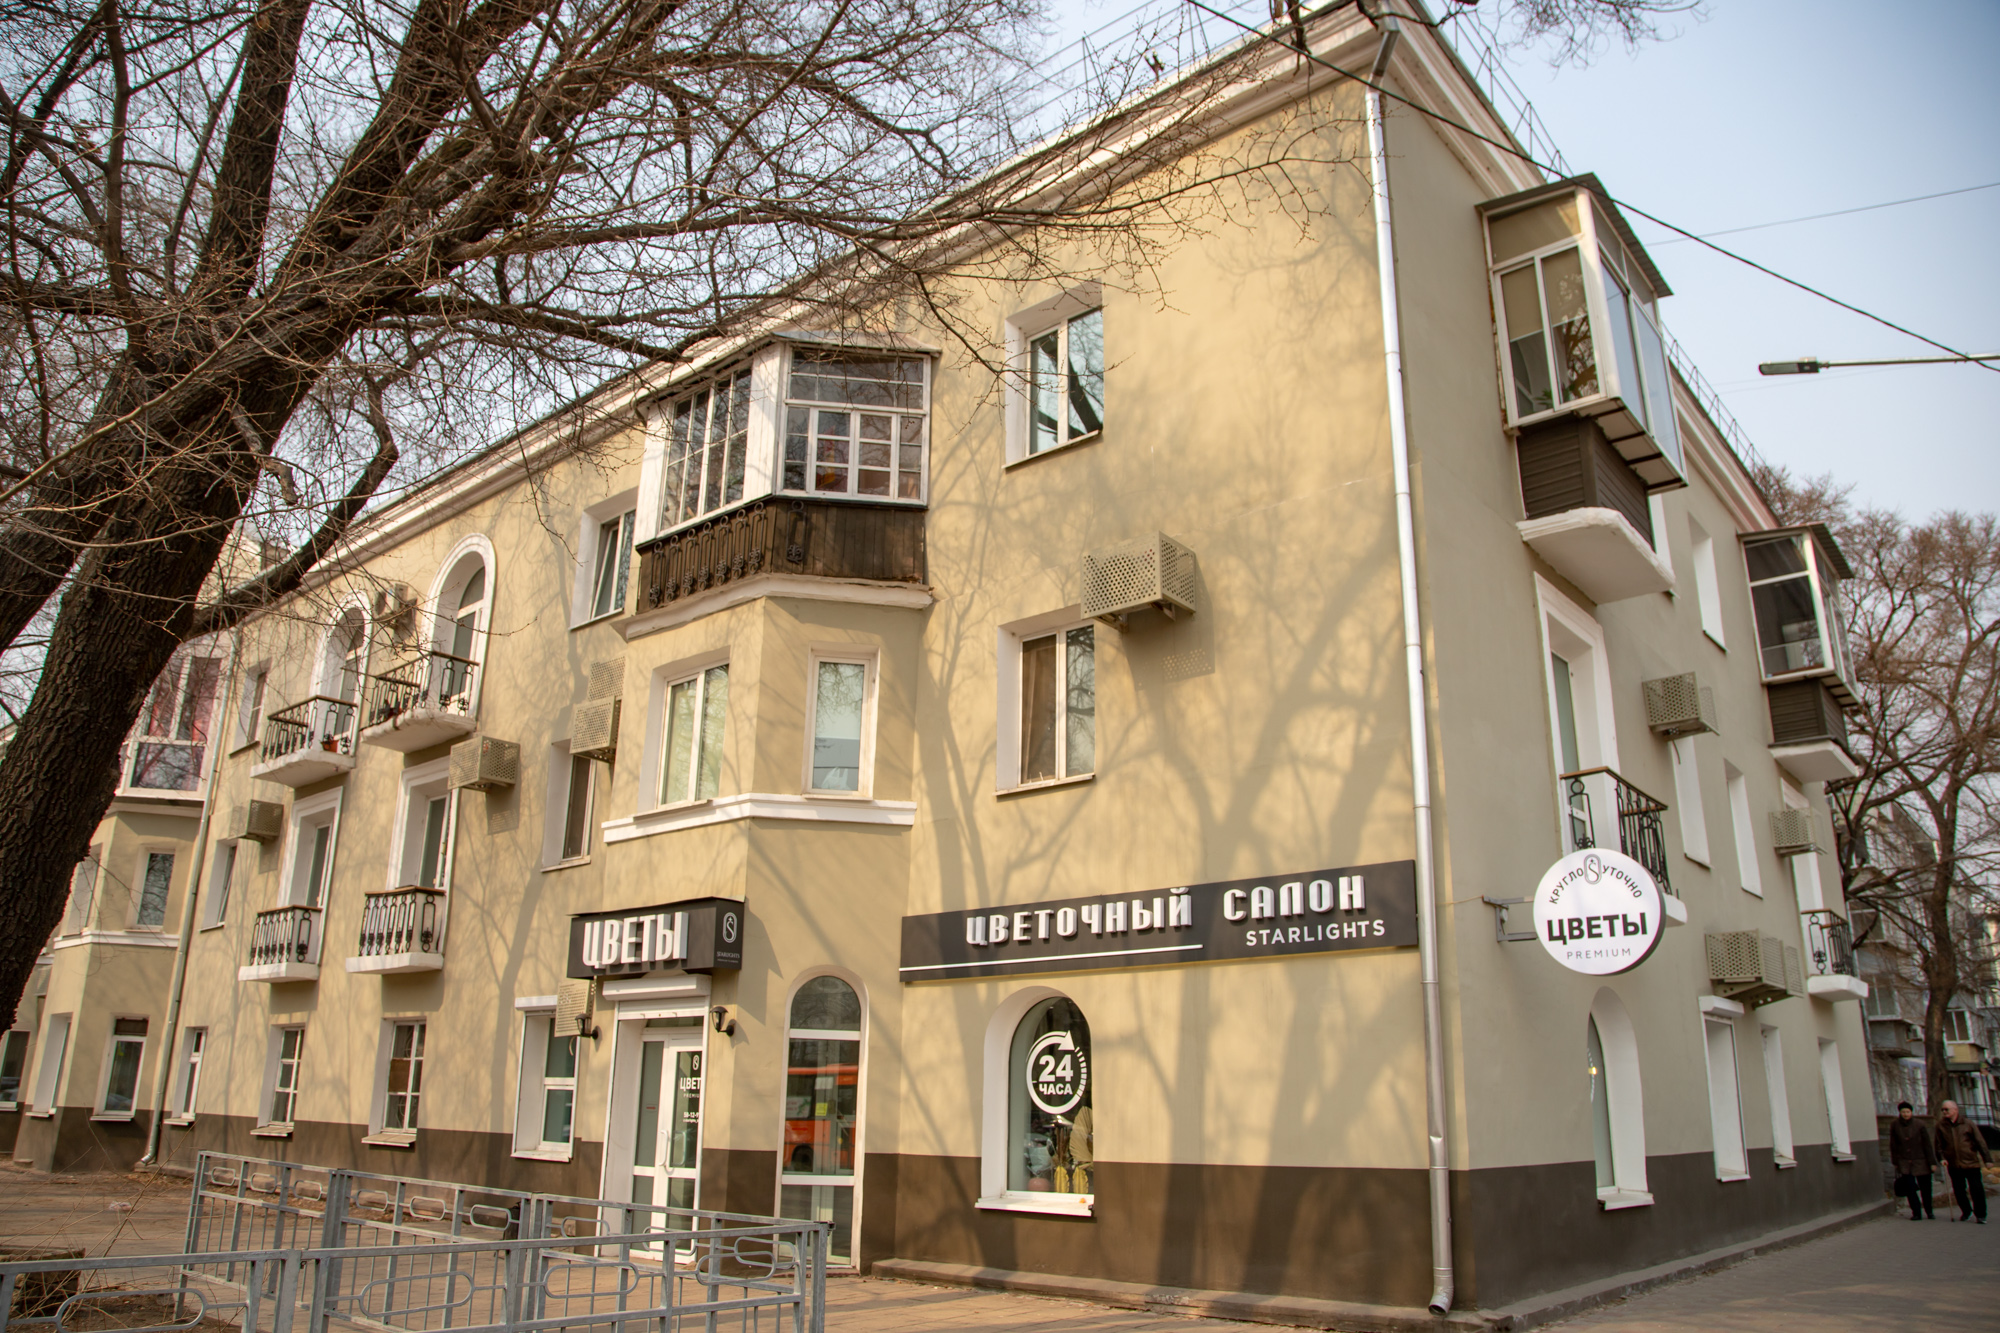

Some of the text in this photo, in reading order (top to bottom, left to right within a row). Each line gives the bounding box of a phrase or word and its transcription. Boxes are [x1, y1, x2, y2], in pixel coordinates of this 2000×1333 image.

[966, 875, 1366, 946] ЦВЕТОЧНЫЙ САЛОН
[582, 911, 688, 969] ЦВЕТЫ
[1246, 919, 1385, 946] STARLIGHTS
[1547, 912, 1648, 945] ЦВЕТЫ
[1567, 948, 1631, 960] PREMIUM
[1038, 1054, 1074, 1082] 24
[680, 1077, 701, 1092] ЦВЕТ
[1038, 1083, 1073, 1095] ЧАСА
